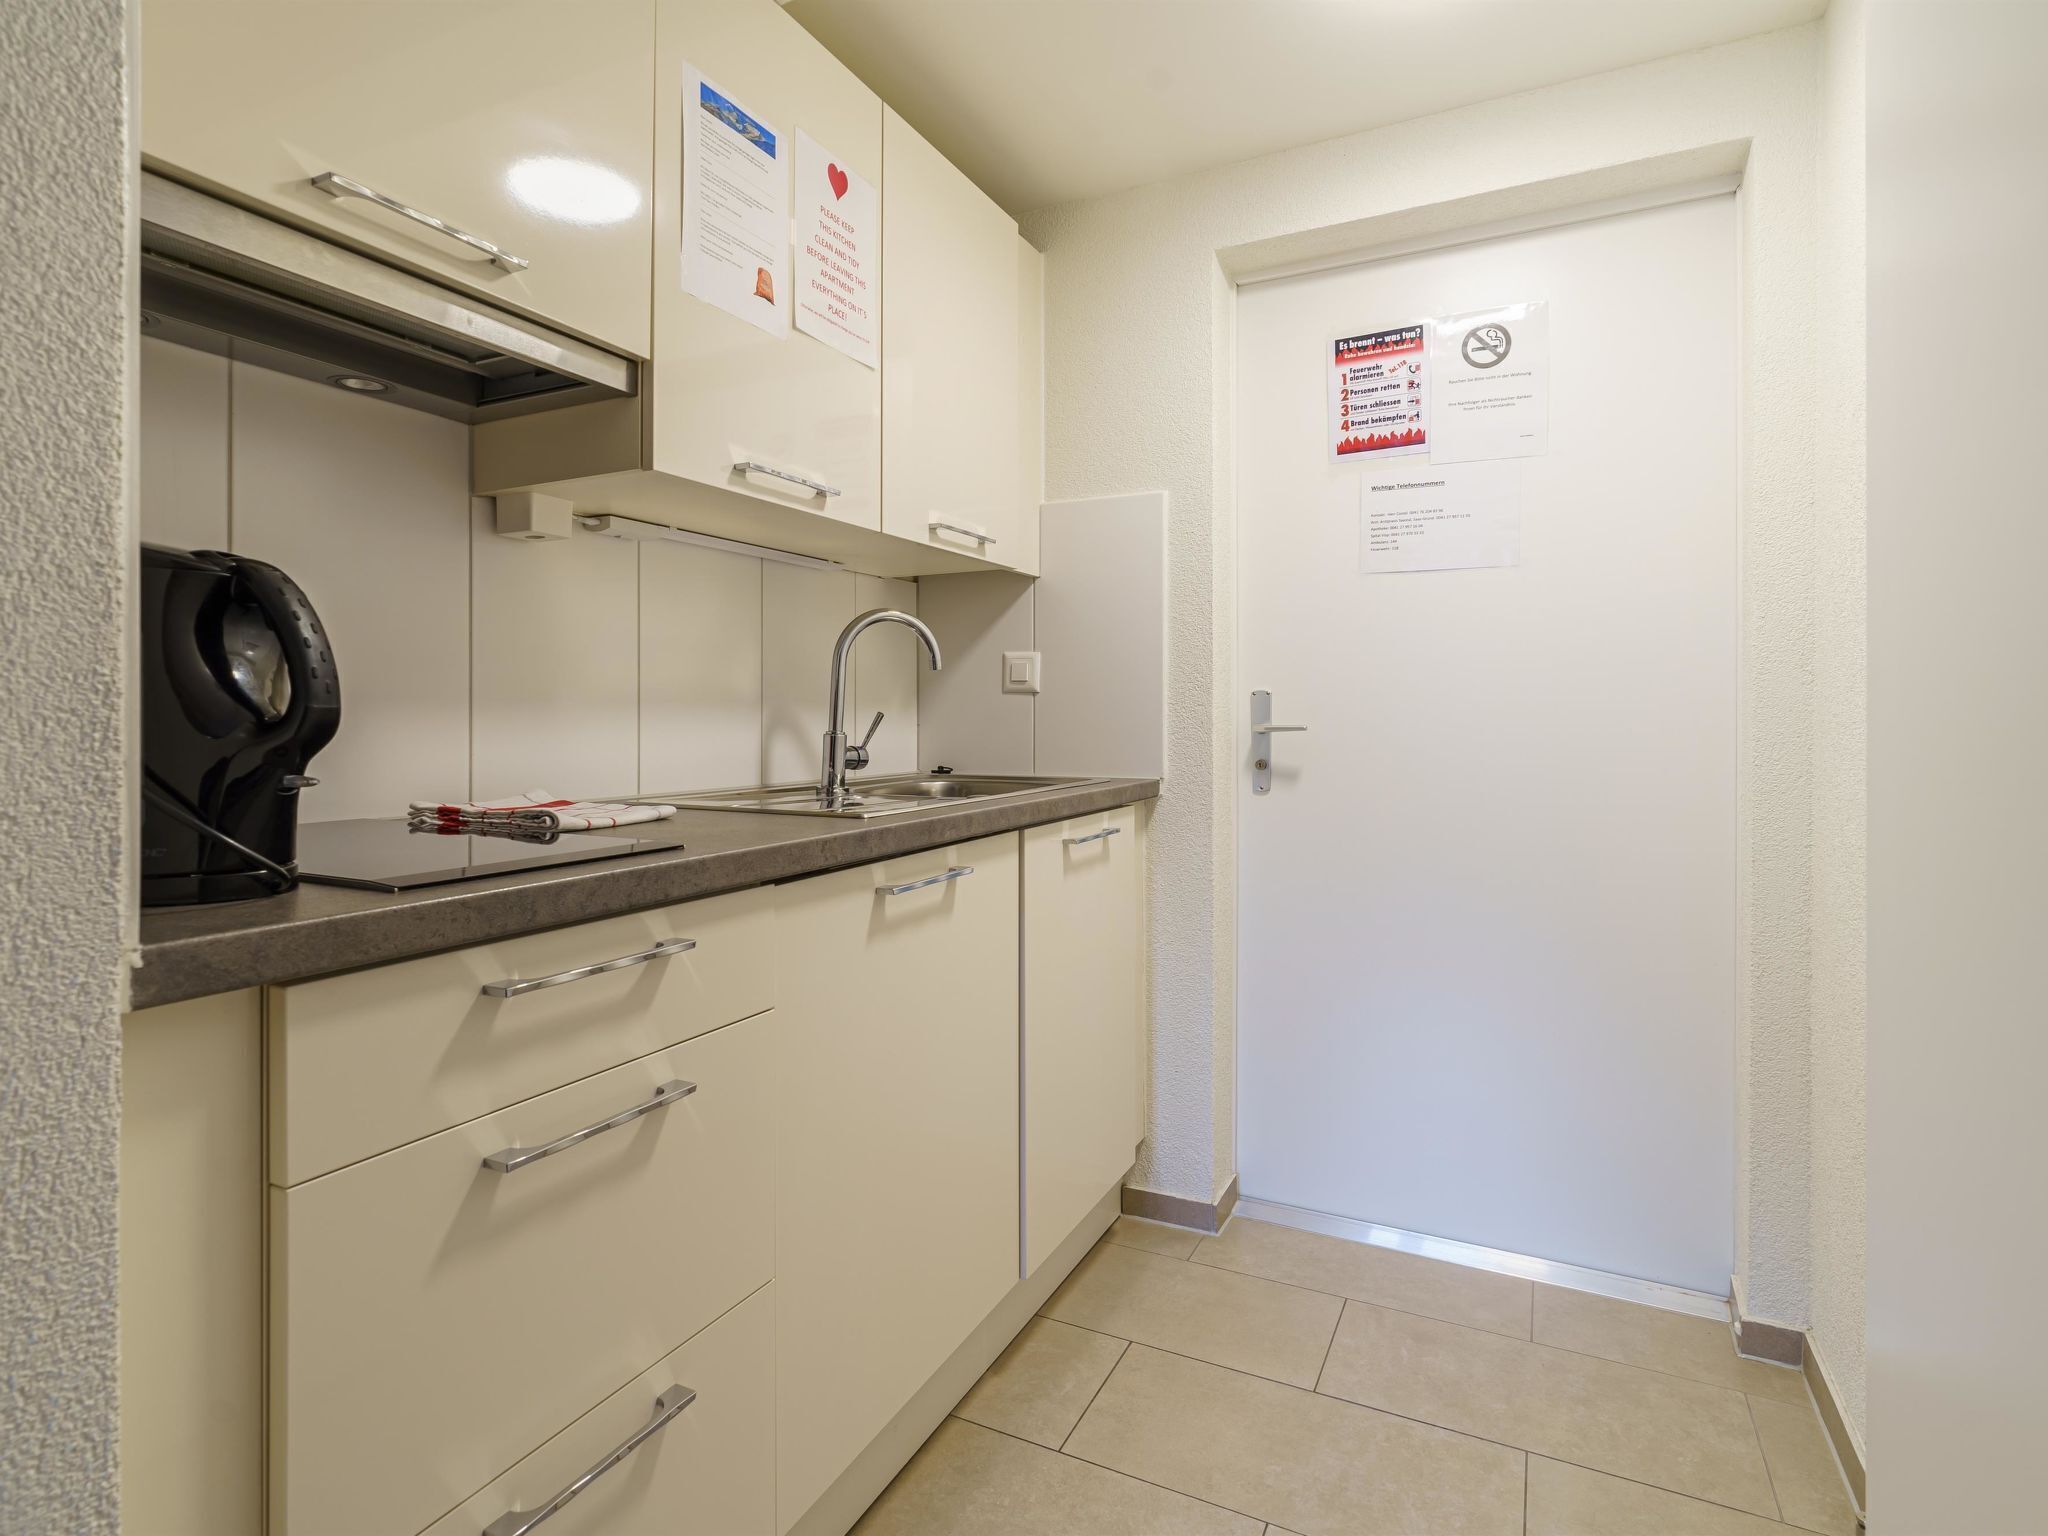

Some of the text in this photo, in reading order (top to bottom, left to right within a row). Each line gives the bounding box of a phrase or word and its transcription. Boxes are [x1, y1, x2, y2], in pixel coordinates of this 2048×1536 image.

[820, 204, 855, 234] PLEASE KEEP
[818, 219, 856, 252] THIS KITCHEN
[814, 234, 860, 269] CLEAN AND TIDY
[806, 244, 866, 290] BEFORE LEAVING THIS
[820, 268, 855, 295] APARTMENT
[811, 279, 847, 307] EVERYTHING
[848, 301, 857, 313] ON
[827, 303, 848, 322] PLACE!
[1339, 341, 1348, 350] Es
[1349, 338, 1376, 349] brennt
[1384, 334, 1401, 343] was
[1402, 329, 1421, 340] tun?
[1349, 364, 1383, 375] Feuerwehr
[1349, 372, 1385, 382] alarmieren
[1341, 374, 1347, 386] 1
[1340, 389, 1350, 402] 2
[1350, 387, 1379, 396] Personen
[1380, 383, 1401, 392] retten
[1340, 405, 1350, 417] 3
[1350, 403, 1368, 412] Türen
[1369, 399, 1401, 410] schliessen
[1340, 420, 1350, 432] 4
[1350, 418, 1370, 427] Brand
[1370, 414, 1407, 425] bekämpfen
[1396, 481, 1446, 490] Telefonnummern
